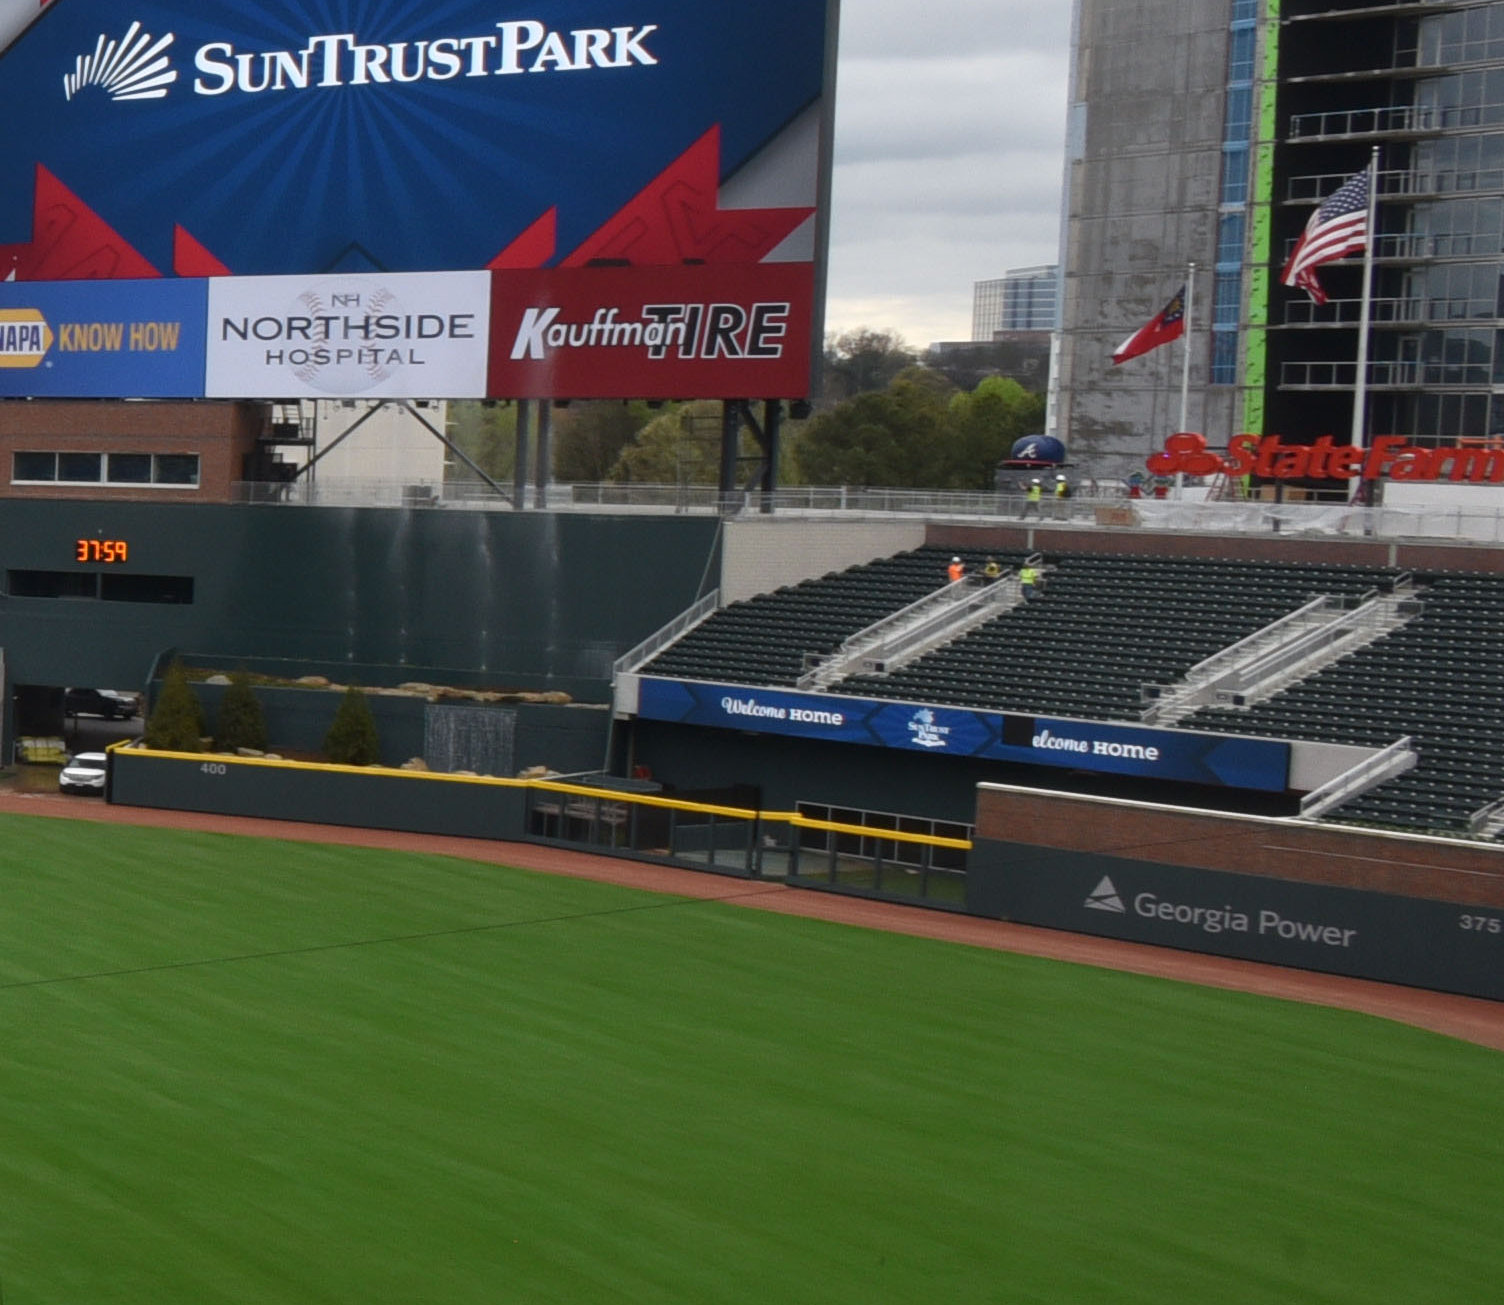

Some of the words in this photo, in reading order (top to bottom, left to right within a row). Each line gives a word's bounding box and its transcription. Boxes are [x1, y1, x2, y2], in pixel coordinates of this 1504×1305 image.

[58, 323, 120, 353] KNOW
[131, 322, 180, 352] HOW
[220, 312, 475, 342] NORTHSIDE
[644, 302, 788, 361] TIRE
[266, 348, 426, 366] HOSPITAL
[1227, 433, 1364, 479] State
[76, 539, 127, 562] 37:59
[722, 697, 786, 718] Welcome
[200, 763, 226, 775] 400
[1134, 892, 1249, 934] Georgia
[1259, 910, 1357, 946] Power
[1458, 914, 1501, 933] 375
